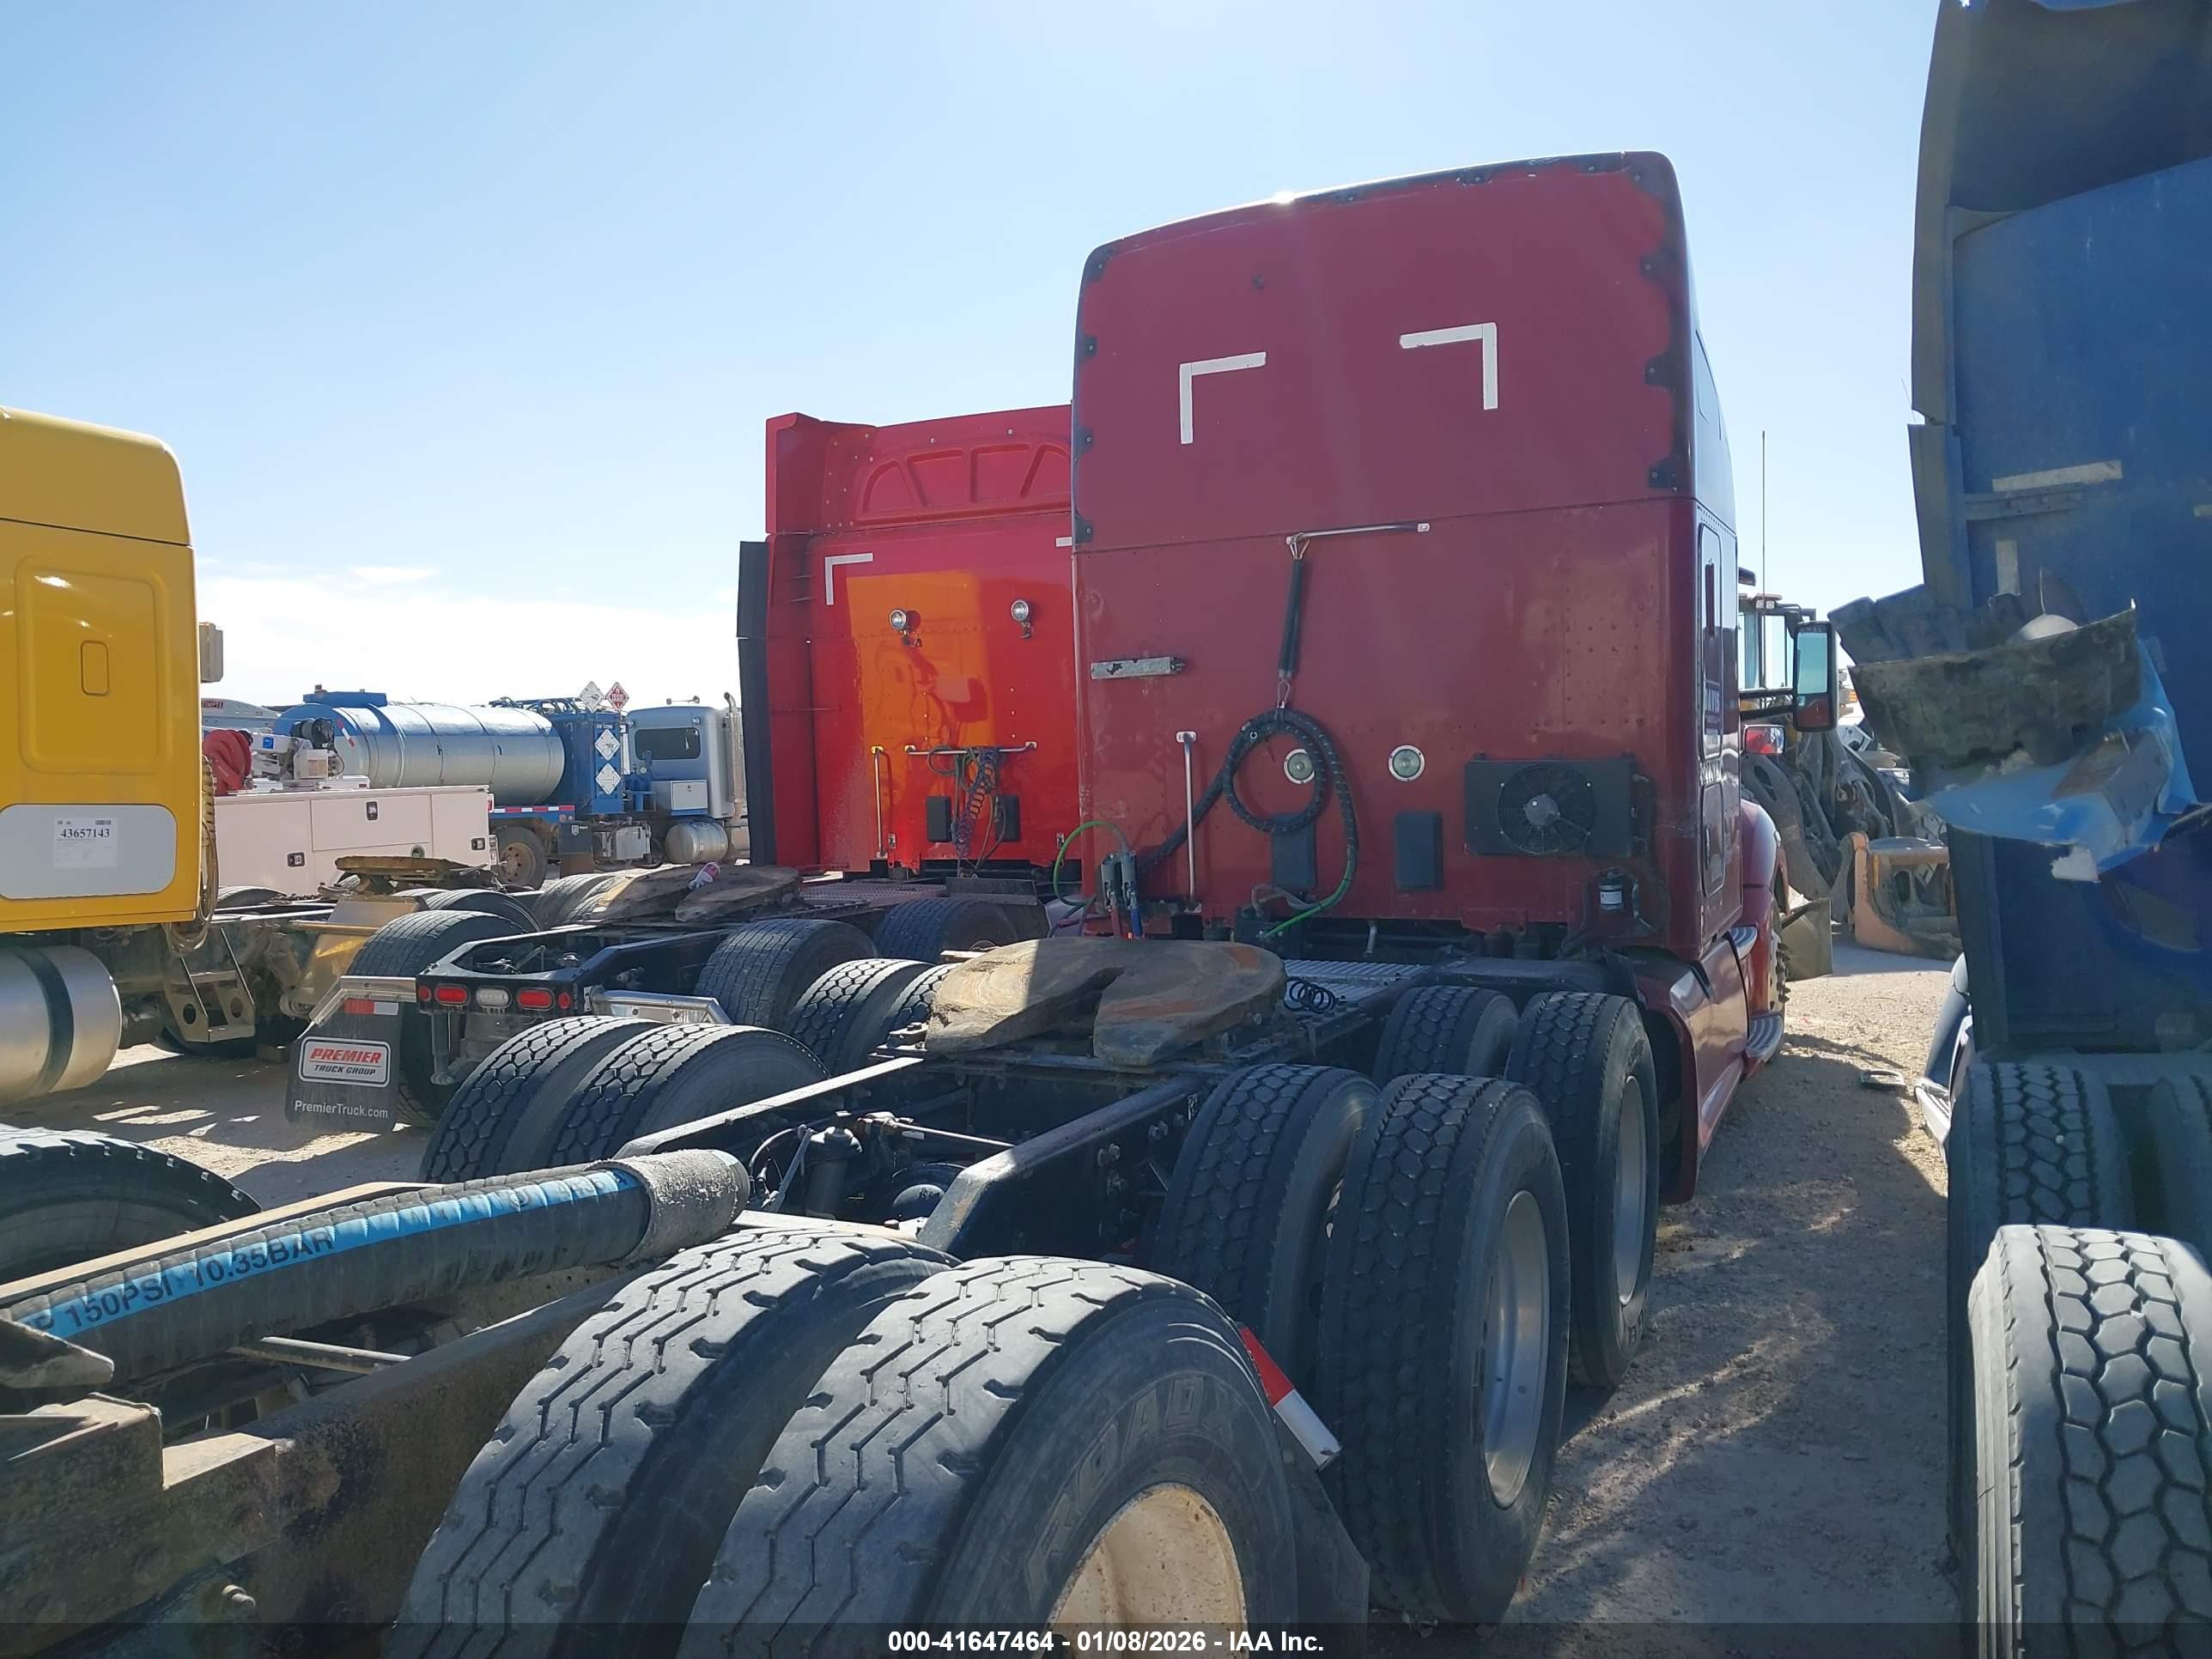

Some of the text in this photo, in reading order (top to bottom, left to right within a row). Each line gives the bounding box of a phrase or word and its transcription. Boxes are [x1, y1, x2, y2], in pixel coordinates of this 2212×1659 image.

[60, 828, 110, 838] 43657143
[310, 1048, 382, 1064] PREMIER
[314, 1064, 377, 1076] TRUCK GROUP
[295, 1100, 388, 1118] PremierTruck.com
[65, 1274, 173, 1328] 150PSI
[191, 1231, 334, 1287] 10.35BAR
